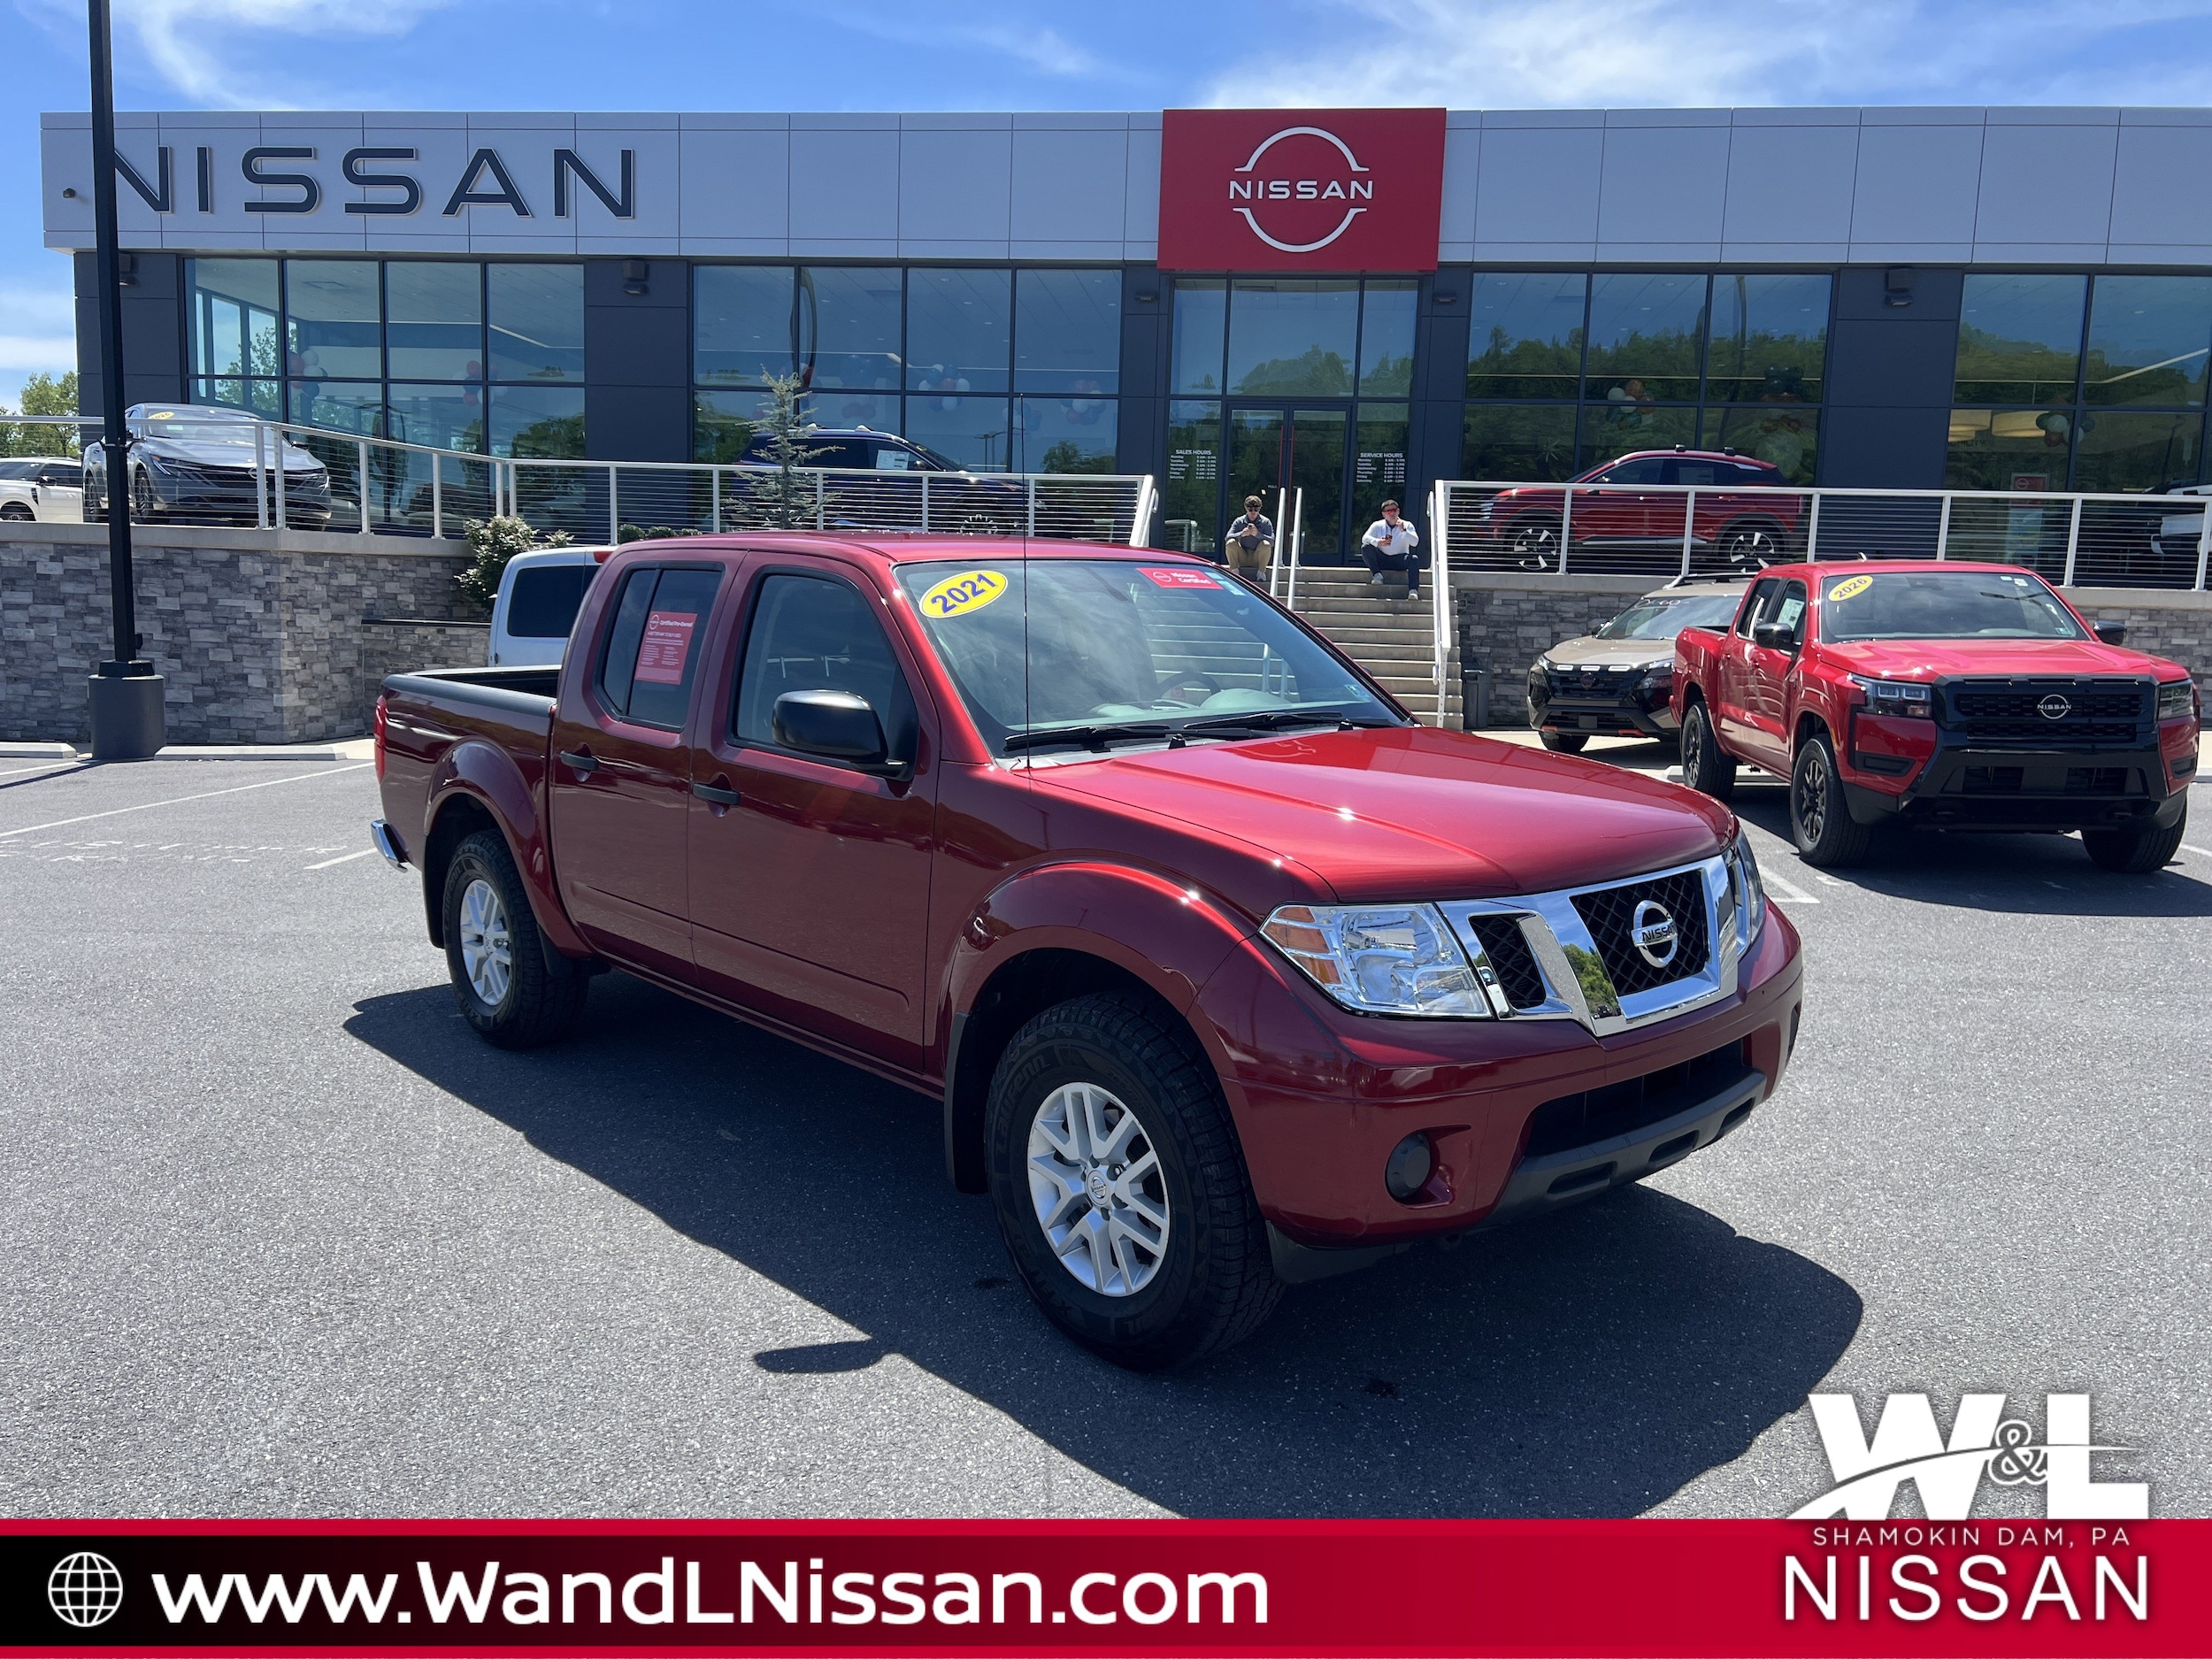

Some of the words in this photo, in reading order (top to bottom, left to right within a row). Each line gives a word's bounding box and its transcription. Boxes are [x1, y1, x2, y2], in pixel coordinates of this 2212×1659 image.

[113, 146, 634, 219] NISSAN
[1229, 180, 1373, 200] NISSAN
[930, 572, 997, 614] 2021
[1833, 578, 1868, 598] 2026
